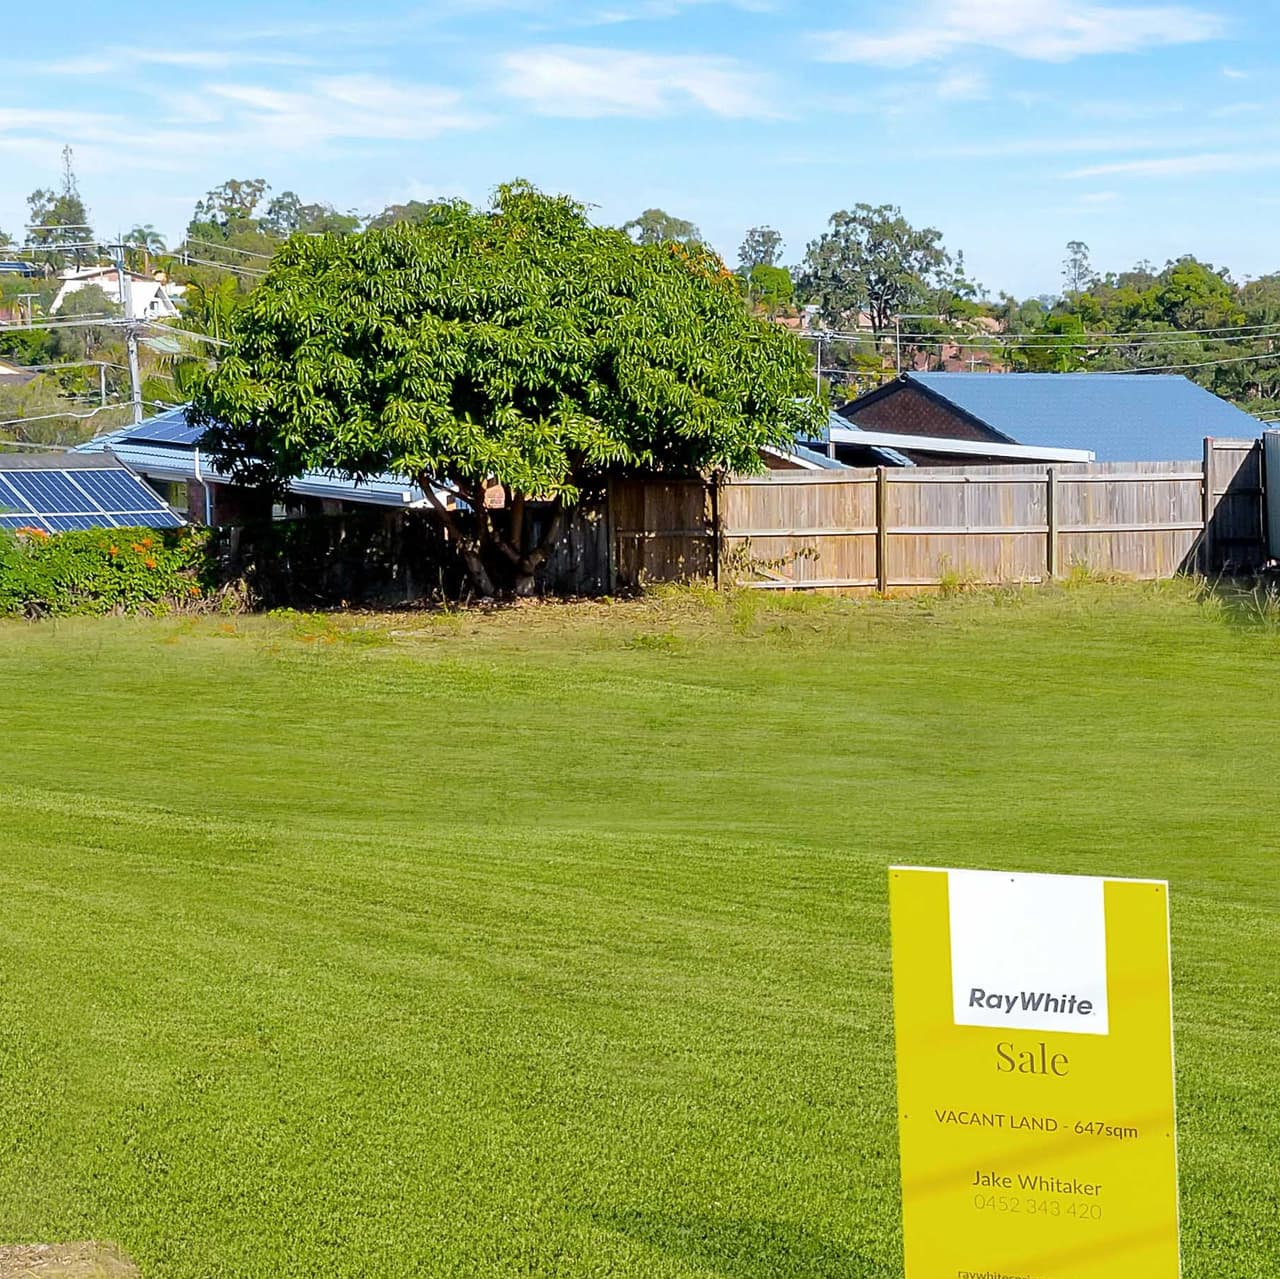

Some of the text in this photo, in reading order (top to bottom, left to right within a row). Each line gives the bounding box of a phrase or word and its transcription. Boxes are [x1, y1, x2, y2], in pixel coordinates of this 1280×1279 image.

[997, 1042, 1069, 1077] Sale
[935, 1110, 1005, 1129] VACANT
[1010, 1116, 1057, 1132] LAND
[1074, 1121, 1138, 1140] 647sqm
[972, 1171, 1102, 1196] Jake Whitaker
[974, 1194, 1102, 1220] 0452 343 420
